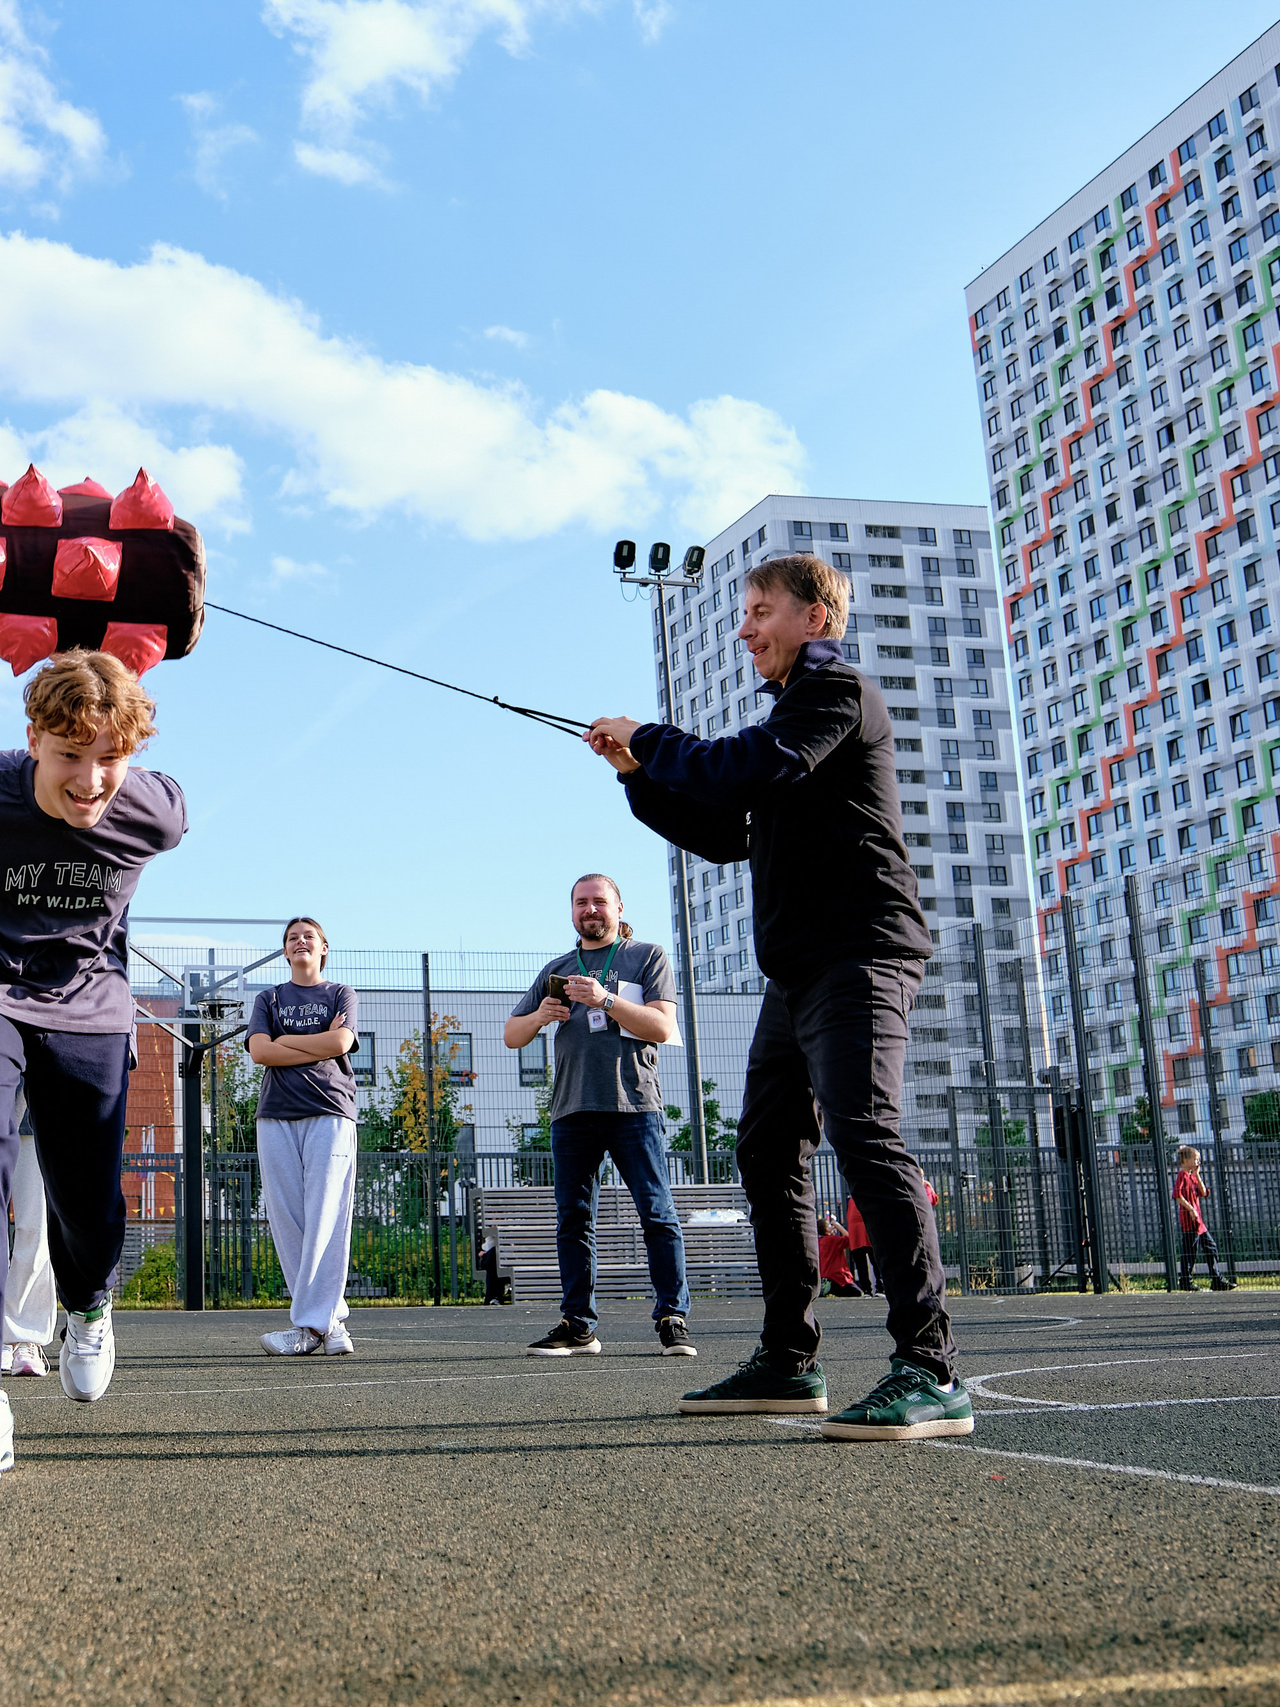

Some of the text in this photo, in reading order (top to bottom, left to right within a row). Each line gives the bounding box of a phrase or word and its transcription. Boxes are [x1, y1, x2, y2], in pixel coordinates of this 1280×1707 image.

[5, 862, 123, 892] MY TEAM
[17, 893, 105, 909] MY W.I.D.E.
[278, 1003, 328, 1018] MY TEAM
[283, 1017, 321, 1028] MY W.I.D.E.
